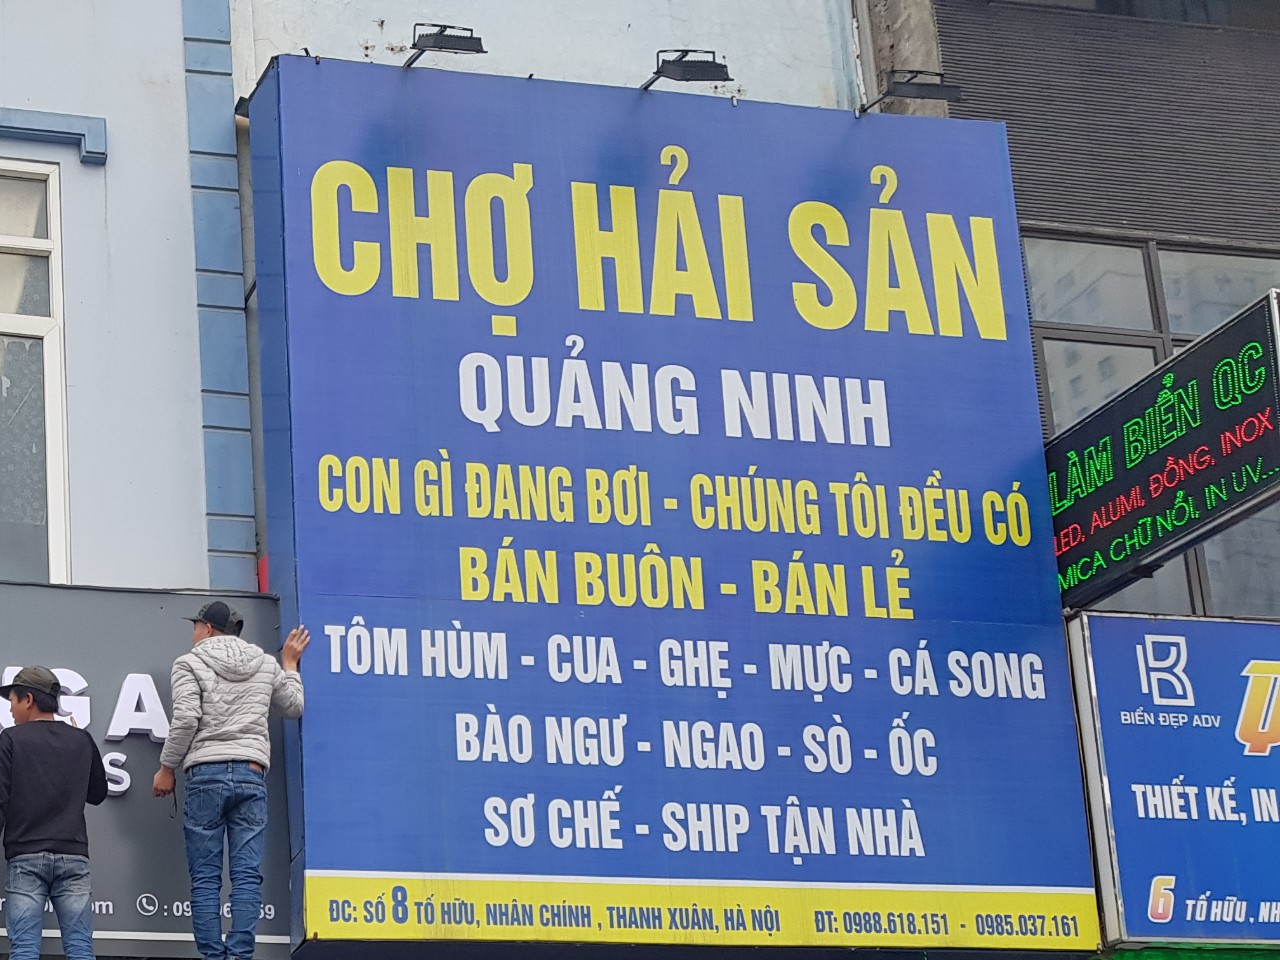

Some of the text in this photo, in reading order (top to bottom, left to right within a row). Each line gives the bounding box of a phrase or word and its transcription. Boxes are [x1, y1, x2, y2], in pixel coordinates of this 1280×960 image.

[310, 145, 1007, 341] CHỢ HẢI SẢN
[459, 334, 892, 447] QUẢNG NINH
[1048, 341, 1267, 516] LÀM BIỂN QC
[1220, 406, 1275, 457] INOX
[318, 448, 1031, 547] CON GÌ ĐANG BƠI CHÚNG TÔI ĐỀU CÓ
[1058, 551, 1108, 594] MICA
[1109, 516, 1153, 561] CHỮ
[1205, 478, 1228, 511] IN
[461, 536, 914, 620] BÁN BUÔN BÁN LẺ
[325, 616, 1046, 703] TÔM HÙM CUA GHẸ MỰC CÁ SONG
[456, 704, 938, 777] BÀO NGƯ NGAO SÒ ỐC
[1120, 706, 1221, 729] BIỂN ĐẸP ADV
[485, 785, 925, 866] SƠ CHẾ SHIP TẬN NHÀ
[1131, 775, 1198, 820] THIẾT
[1205, 777, 1247, 825] KẾ,
[329, 886, 781, 938] ĐC: SỐ 8 TỐ HỮU, NHÂN CHÍNH THANH XUÂN, HÀ NỘI
[814, 910, 1080, 939] ĐT: 0988.618.151 0985.037.161
[1148, 875, 1176, 923] 6
[1186, 891, 1207, 922] TỐ
[1210, 897, 1246, 923] HỮU
